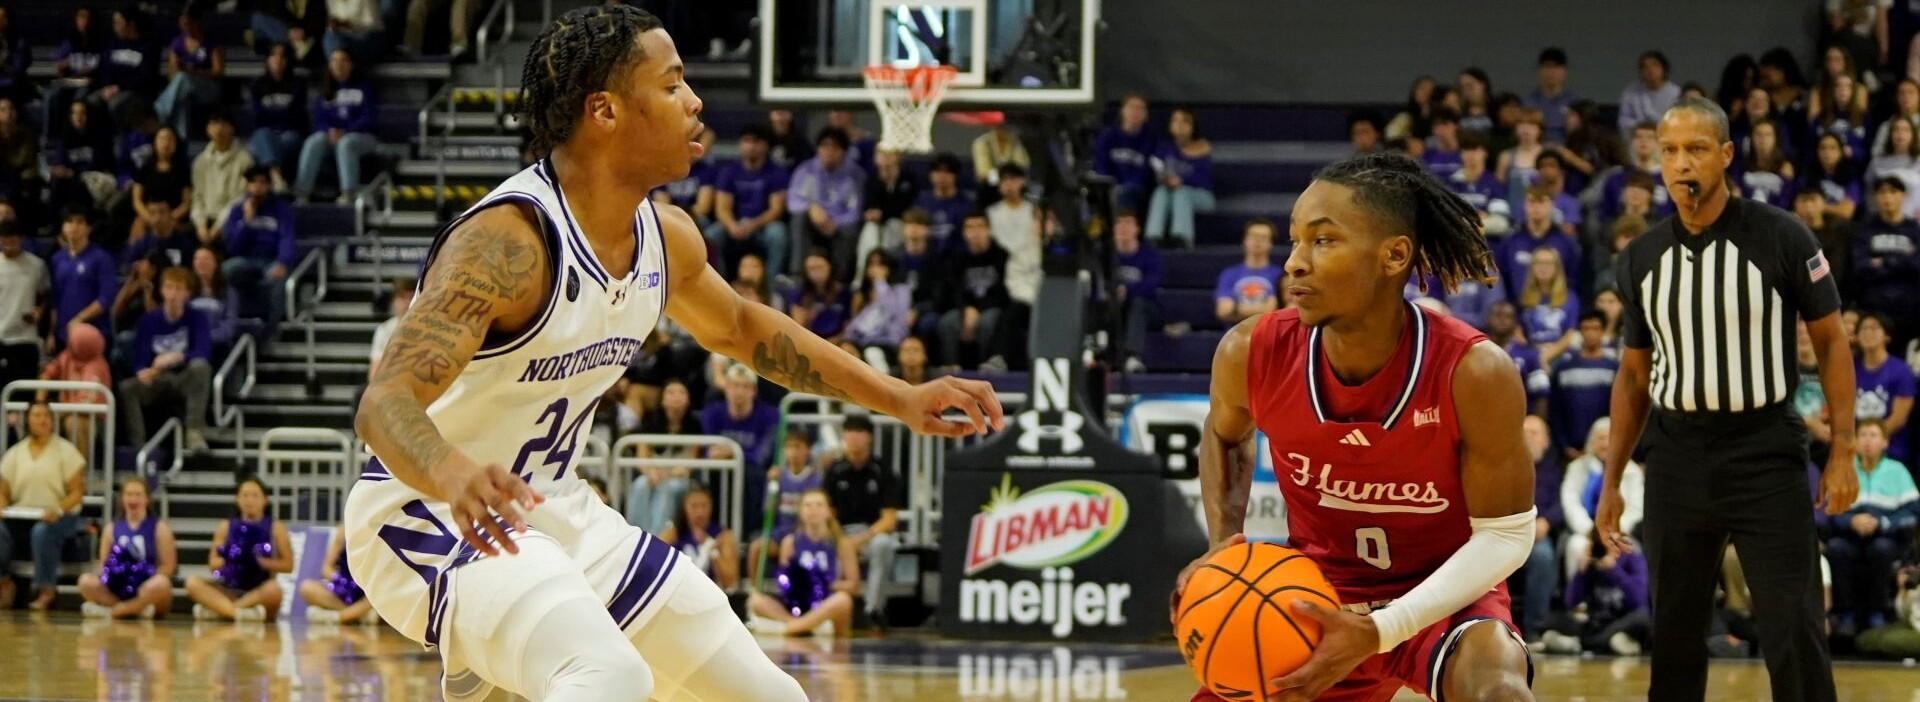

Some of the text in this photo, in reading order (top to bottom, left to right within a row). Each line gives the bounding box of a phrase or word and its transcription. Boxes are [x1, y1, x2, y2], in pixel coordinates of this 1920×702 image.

[1034, 358, 1070, 411] N
[511, 397, 600, 482] 24
[1288, 453, 1444, 505] Flames
[966, 497, 1110, 567] LIBMAN
[1355, 527, 1391, 569] 0
[960, 566, 1130, 637] meijer
